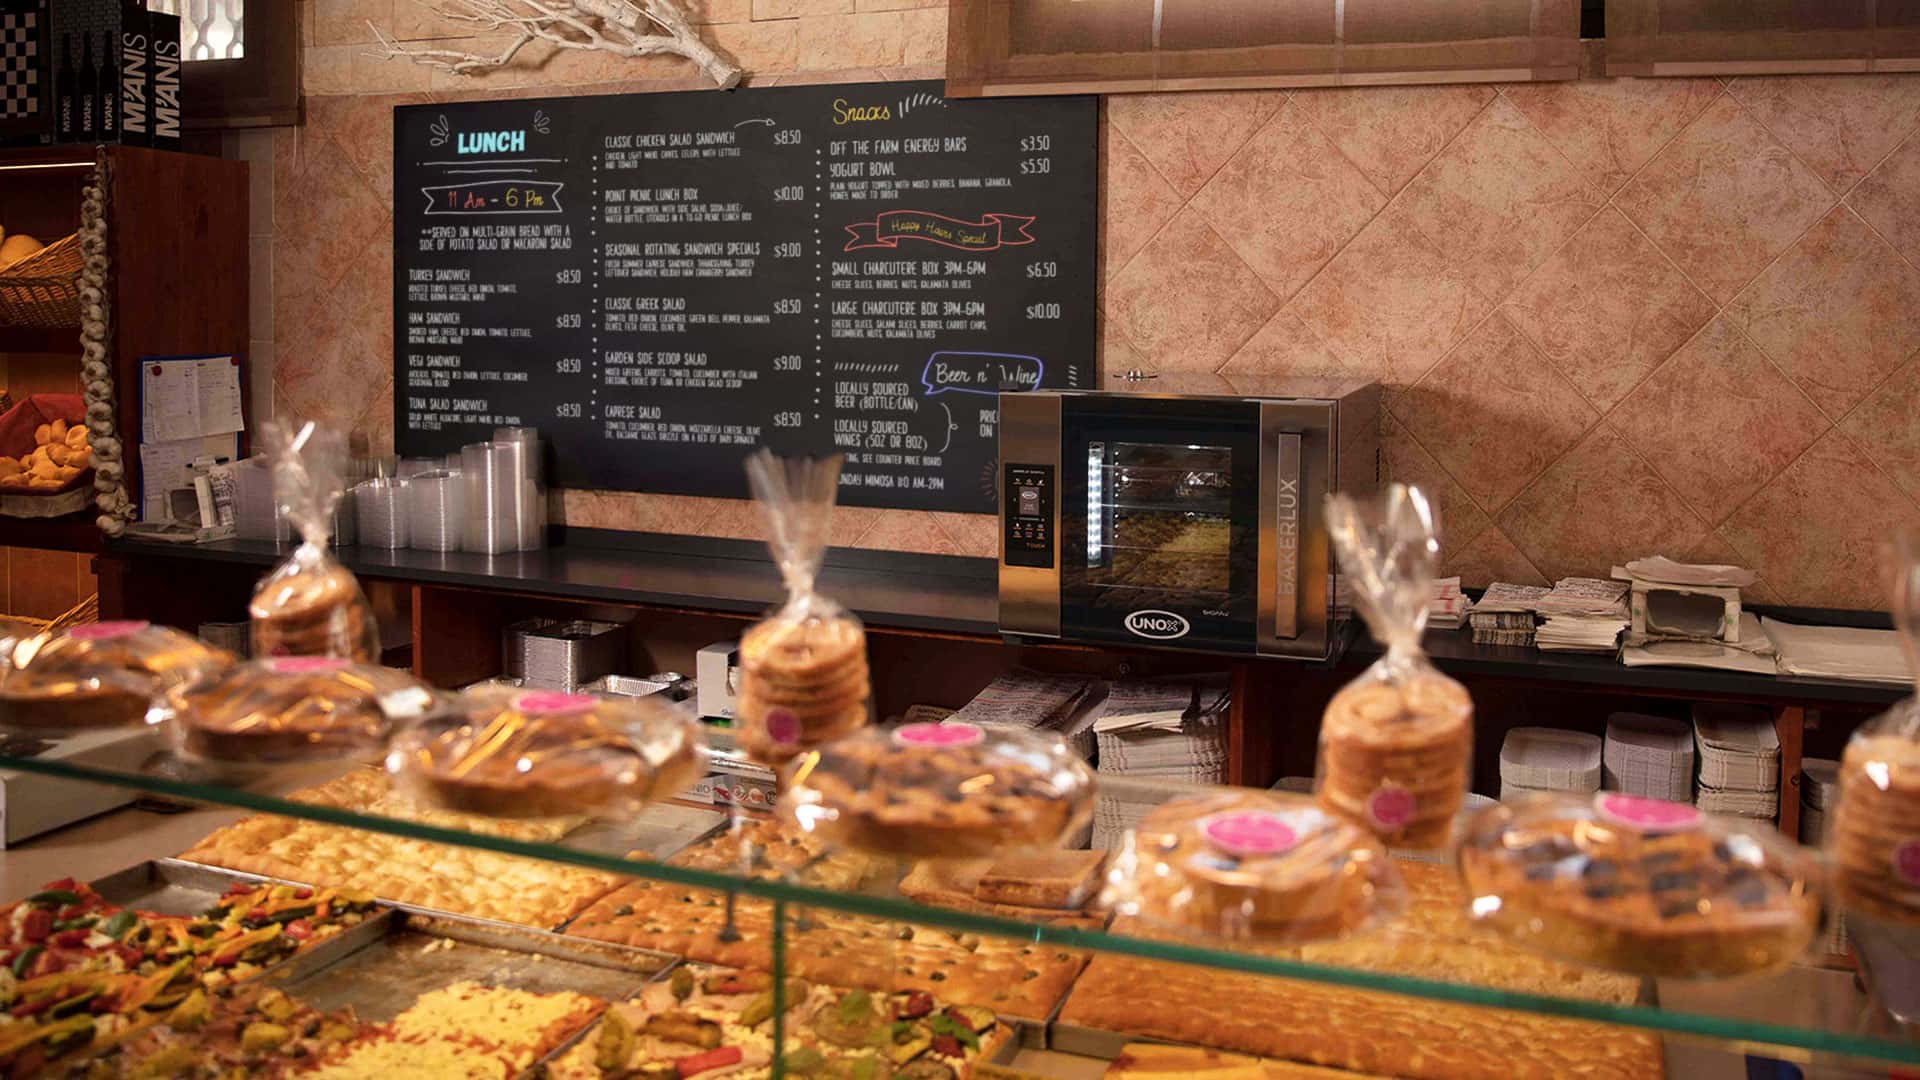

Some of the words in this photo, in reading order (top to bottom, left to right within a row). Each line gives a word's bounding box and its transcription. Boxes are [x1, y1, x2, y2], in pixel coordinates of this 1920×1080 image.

[833, 99, 891, 125] Snacks
[457, 130, 525, 154] LUNCH
[605, 135, 632, 148] CLASSIC
[636, 133, 666, 147] CHICKEN
[669, 132, 692, 146] SALAD
[695, 131, 736, 145] SANDWICH
[830, 141, 847, 156] OFF
[853, 140, 870, 155] THE
[874, 139, 900, 155] FARM
[903, 137, 940, 154] ENERGY
[944, 136, 967, 153] BARS
[1020, 135, 1050, 151] $3.50
[829, 162, 864, 178] YOGURT
[869, 162, 896, 177] BOWL
[1020, 158, 1050, 174] $5.50
[448, 191, 457, 208] 11
[506, 188, 518, 207] 6
[605, 190, 626, 202] POINT
[629, 189, 652, 202] PICNIC
[655, 188, 680, 201] LUNCH
[683, 188, 698, 201] BOX
[459, 226, 470, 237] ON
[519, 226, 540, 236] BREAD
[543, 225, 562, 236] WITH
[419, 239, 433, 250] SIDE
[437, 239, 445, 250] OF
[449, 239, 475, 250] POTATO
[477, 239, 498, 250] SALAD
[500, 238, 511, 250] OR
[513, 238, 548, 250] MACARONI
[550, 238, 572, 249] SALAD
[605, 243, 640, 256] SEASONAL
[644, 243, 681, 256] ROTATING
[684, 242, 724, 255] SANDWICH
[726, 242, 761, 255] SPECIALS
[774, 242, 801, 257] $9.00
[436, 269, 470, 281] SANDWICH
[831, 261, 858, 276] SMALL
[921, 261, 939, 275] BOX
[944, 261, 986, 275] 3PM-6PM
[1026, 262, 1057, 278] $6.50
[604, 298, 632, 310] CLASSIC
[635, 298, 659, 310] GREEK
[662, 298, 686, 310] SALAD
[831, 302, 857, 315] LARGE
[920, 302, 938, 315] BOX
[943, 302, 986, 316] 3PM-6PM
[1026, 303, 1061, 319] $10.00
[409, 312, 423, 324] HAM
[426, 312, 460, 324] SANDWICH
[426, 355, 461, 368] SANDWICH
[604, 352, 634, 365] GARDEN
[637, 352, 653, 365] SIDE
[657, 353, 681, 366] SCOOP
[684, 353, 707, 366] SALAD
[936, 363, 971, 384] Beer
[835, 382, 869, 395] LOCALLY
[872, 382, 909, 396] SOURCED
[409, 397, 427, 410] TUNA
[429, 398, 450, 410] SALAD
[452, 398, 488, 412] SANDWICH
[834, 396, 856, 409] BEER
[604, 405, 635, 419] CAPRESE
[638, 406, 662, 420] SALAD
[979, 410, 999, 424] PRIC
[834, 420, 868, 433] LOCALLY
[871, 422, 909, 434] SOURCED
[979, 424, 993, 437] ON
[834, 433, 861, 447] WINES
[889, 435, 902, 449] OR
[862, 454, 872, 464] SEE
[864, 474, 894, 487] MIMOSA
[1278, 479, 1297, 596] BAKERLUX
[1132, 616, 1180, 632] UNOX
